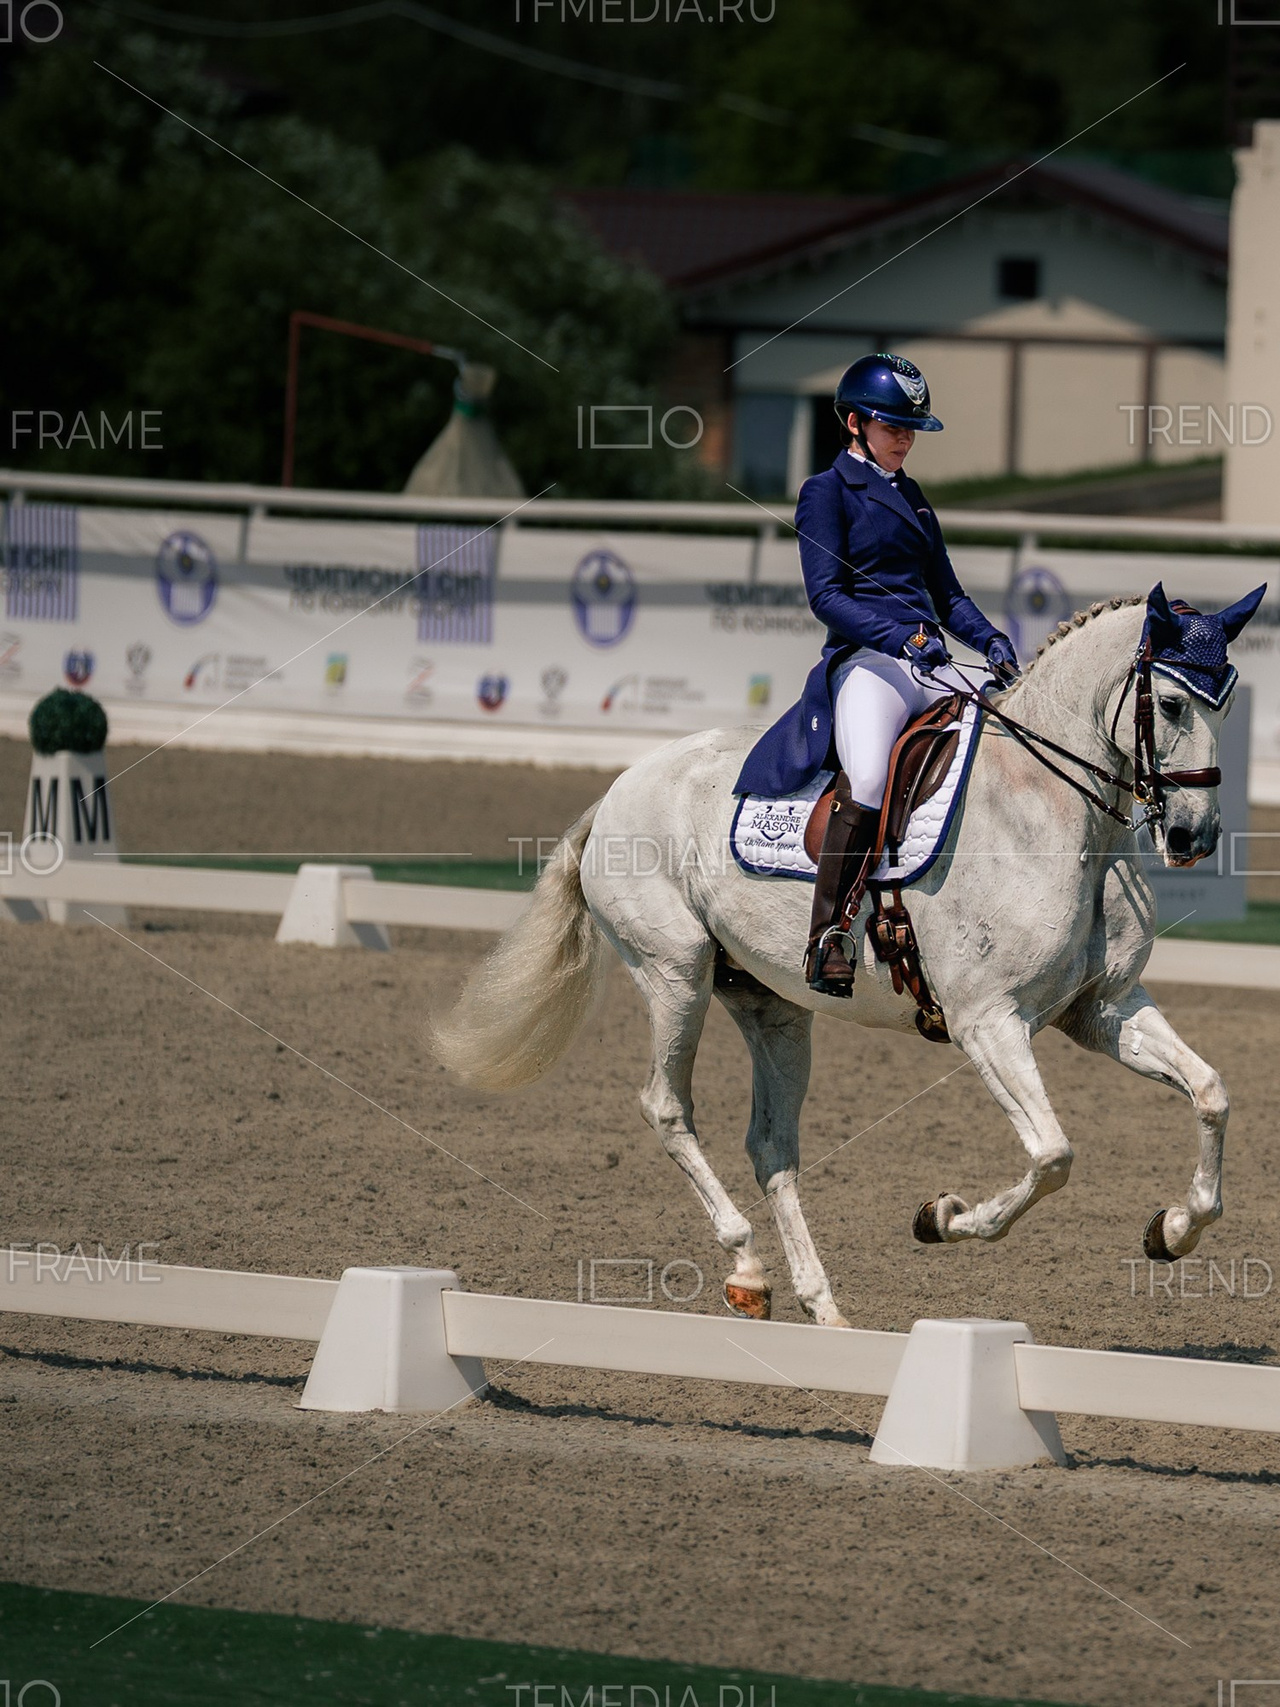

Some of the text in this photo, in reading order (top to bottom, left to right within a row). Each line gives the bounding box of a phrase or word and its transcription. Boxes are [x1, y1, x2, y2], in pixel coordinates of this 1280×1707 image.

[31, 777, 58, 842] M
[70, 777, 110, 842] M
[751, 819, 800, 834] MASON
[754, 813, 801, 823] ALEXANDRE
